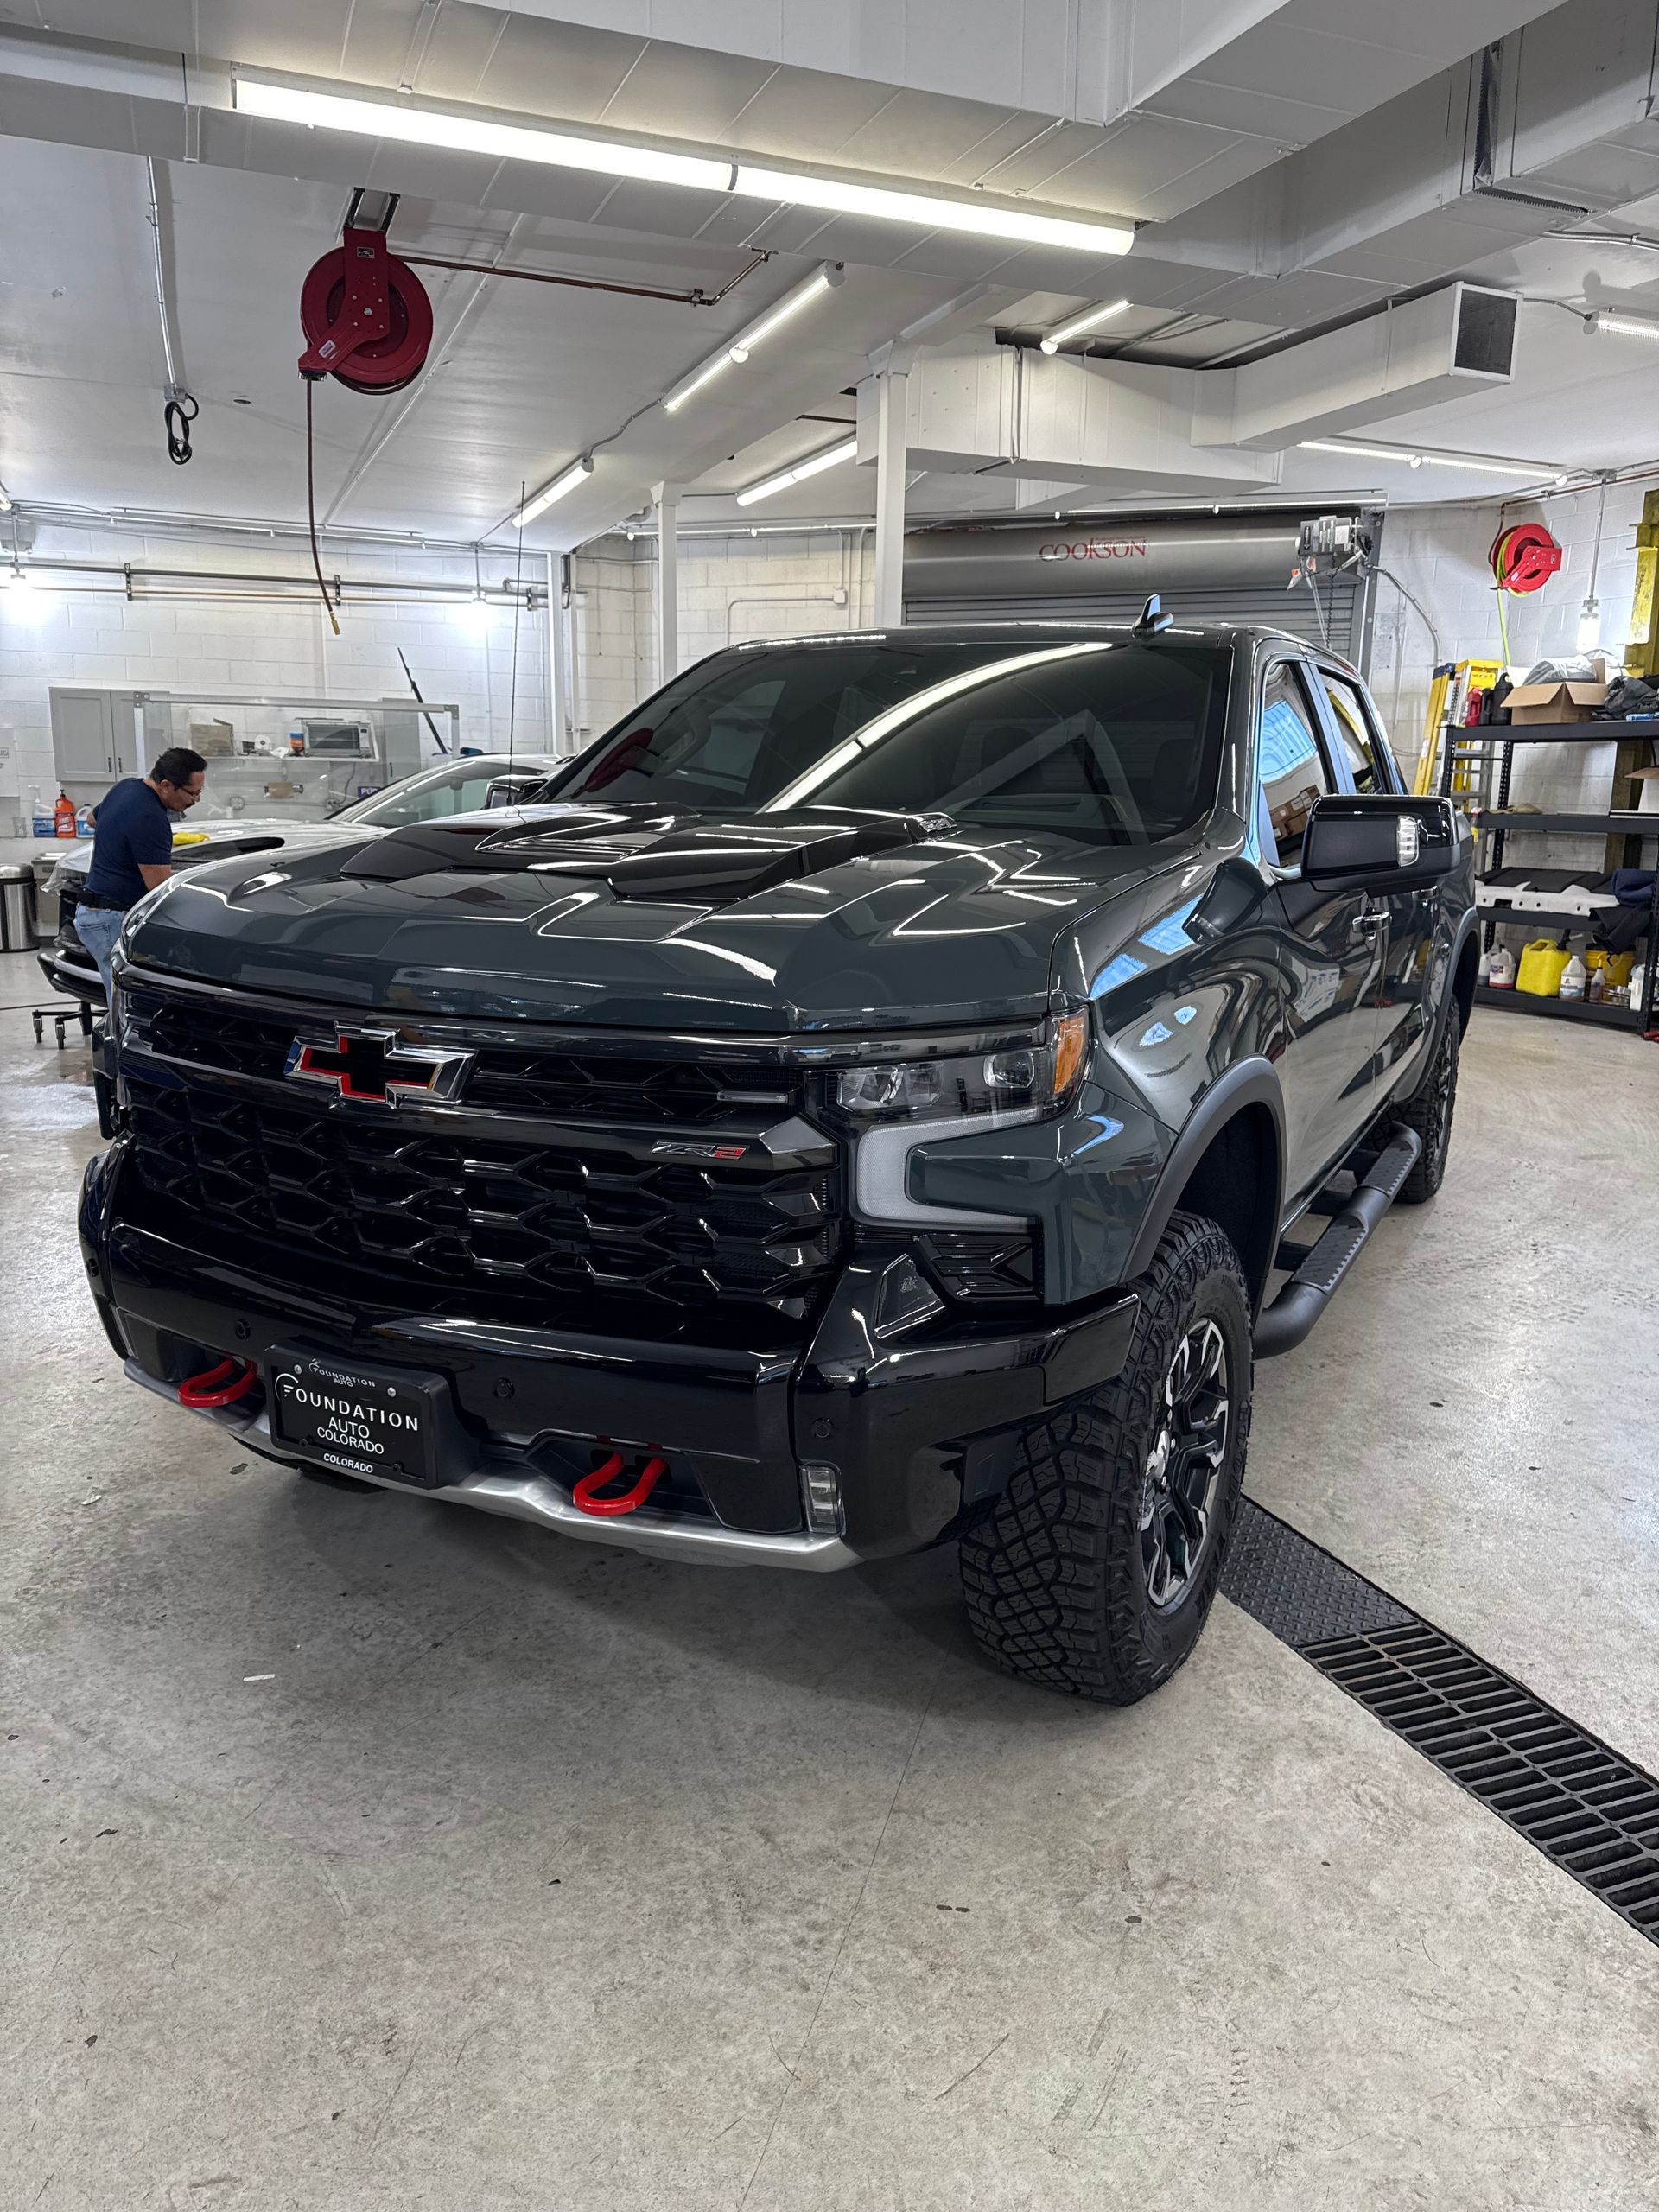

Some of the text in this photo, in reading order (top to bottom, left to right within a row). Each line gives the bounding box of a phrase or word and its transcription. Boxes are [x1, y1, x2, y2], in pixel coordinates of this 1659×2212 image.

[1039, 538, 1147, 562] COOKSON
[651, 1141, 747, 1160] ZR2
[328, 1416, 370, 1440] AUTO
[317, 1427, 385, 1455] COLORADO
[323, 1452, 373, 1474] COLORADO
